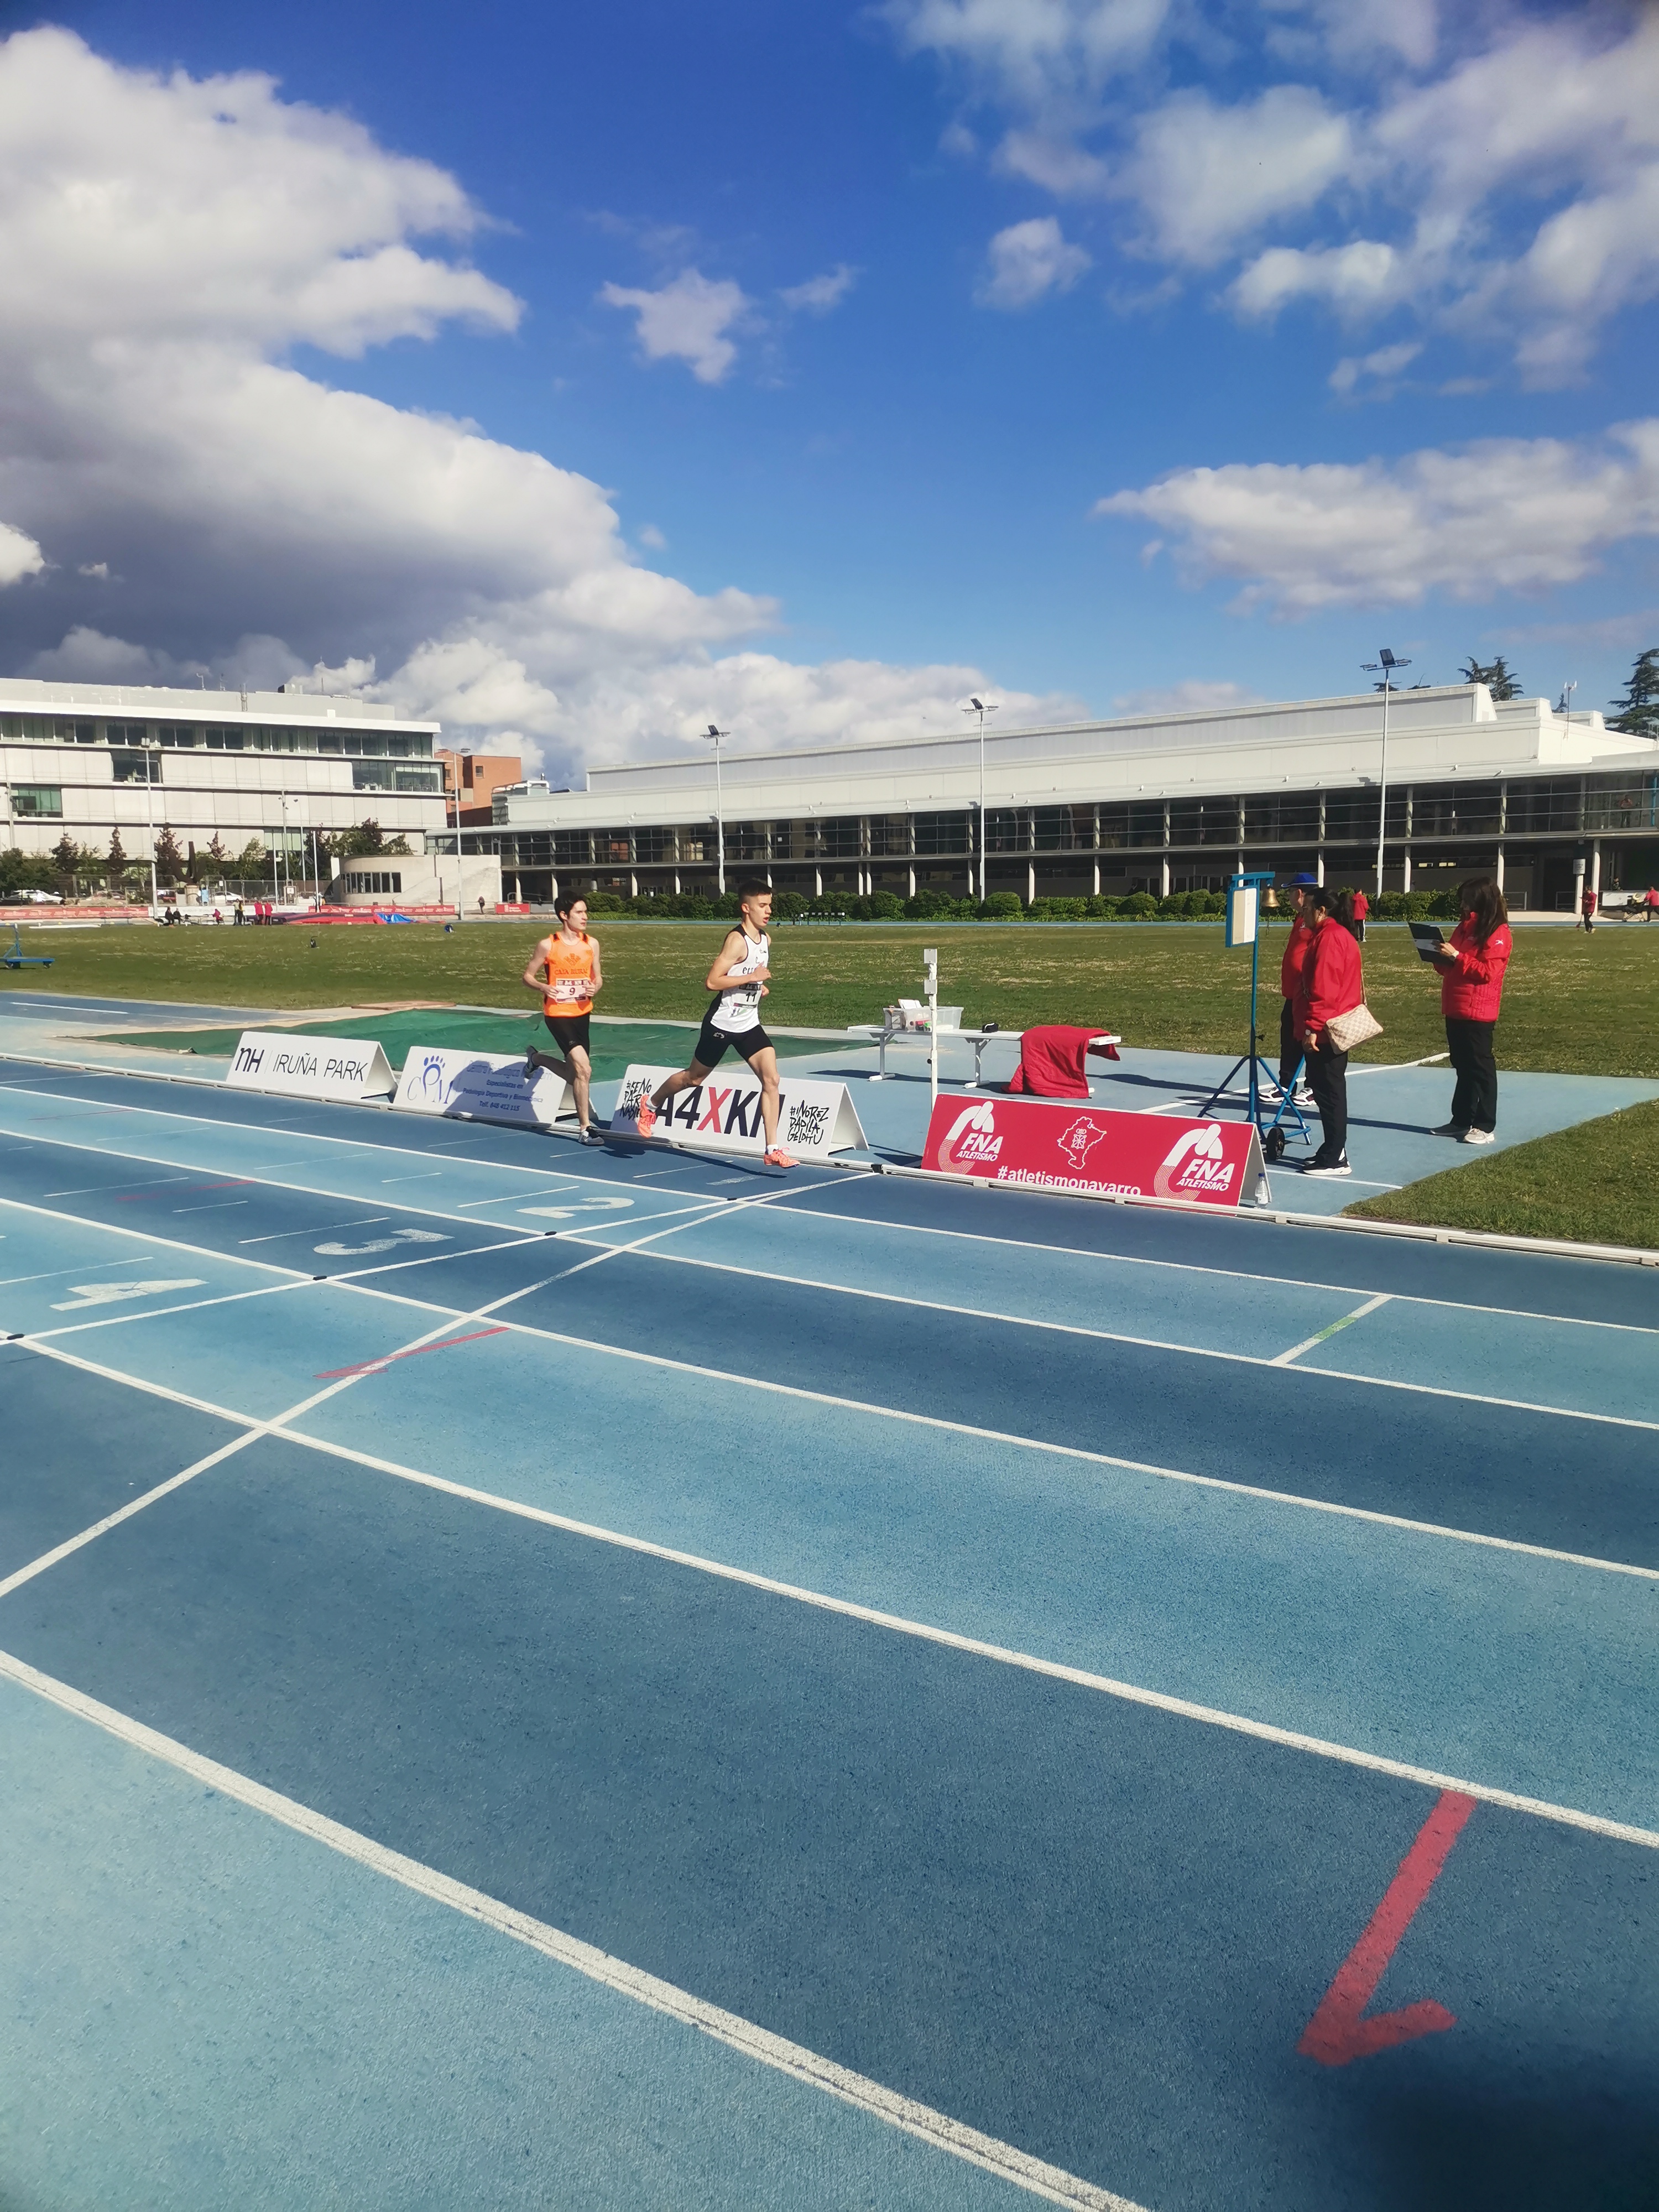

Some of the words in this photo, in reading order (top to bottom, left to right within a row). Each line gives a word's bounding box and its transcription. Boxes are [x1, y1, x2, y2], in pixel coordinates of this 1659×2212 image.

[569, 987, 576, 995] 9
[745, 992, 757, 1002] 11
[273, 1052, 317, 1076] IRUÑA
[324, 1058, 368, 1082] PARK
[624, 1089, 642, 1108] PAR
[961, 1133, 1003, 1154] FNA
[956, 1150, 998, 1162] ATLETISMO
[997, 1165, 1141, 1196] #atletismonavarro
[1182, 1159, 1235, 1183] FNA
[1176, 1177, 1229, 1192] ATLETISMO
